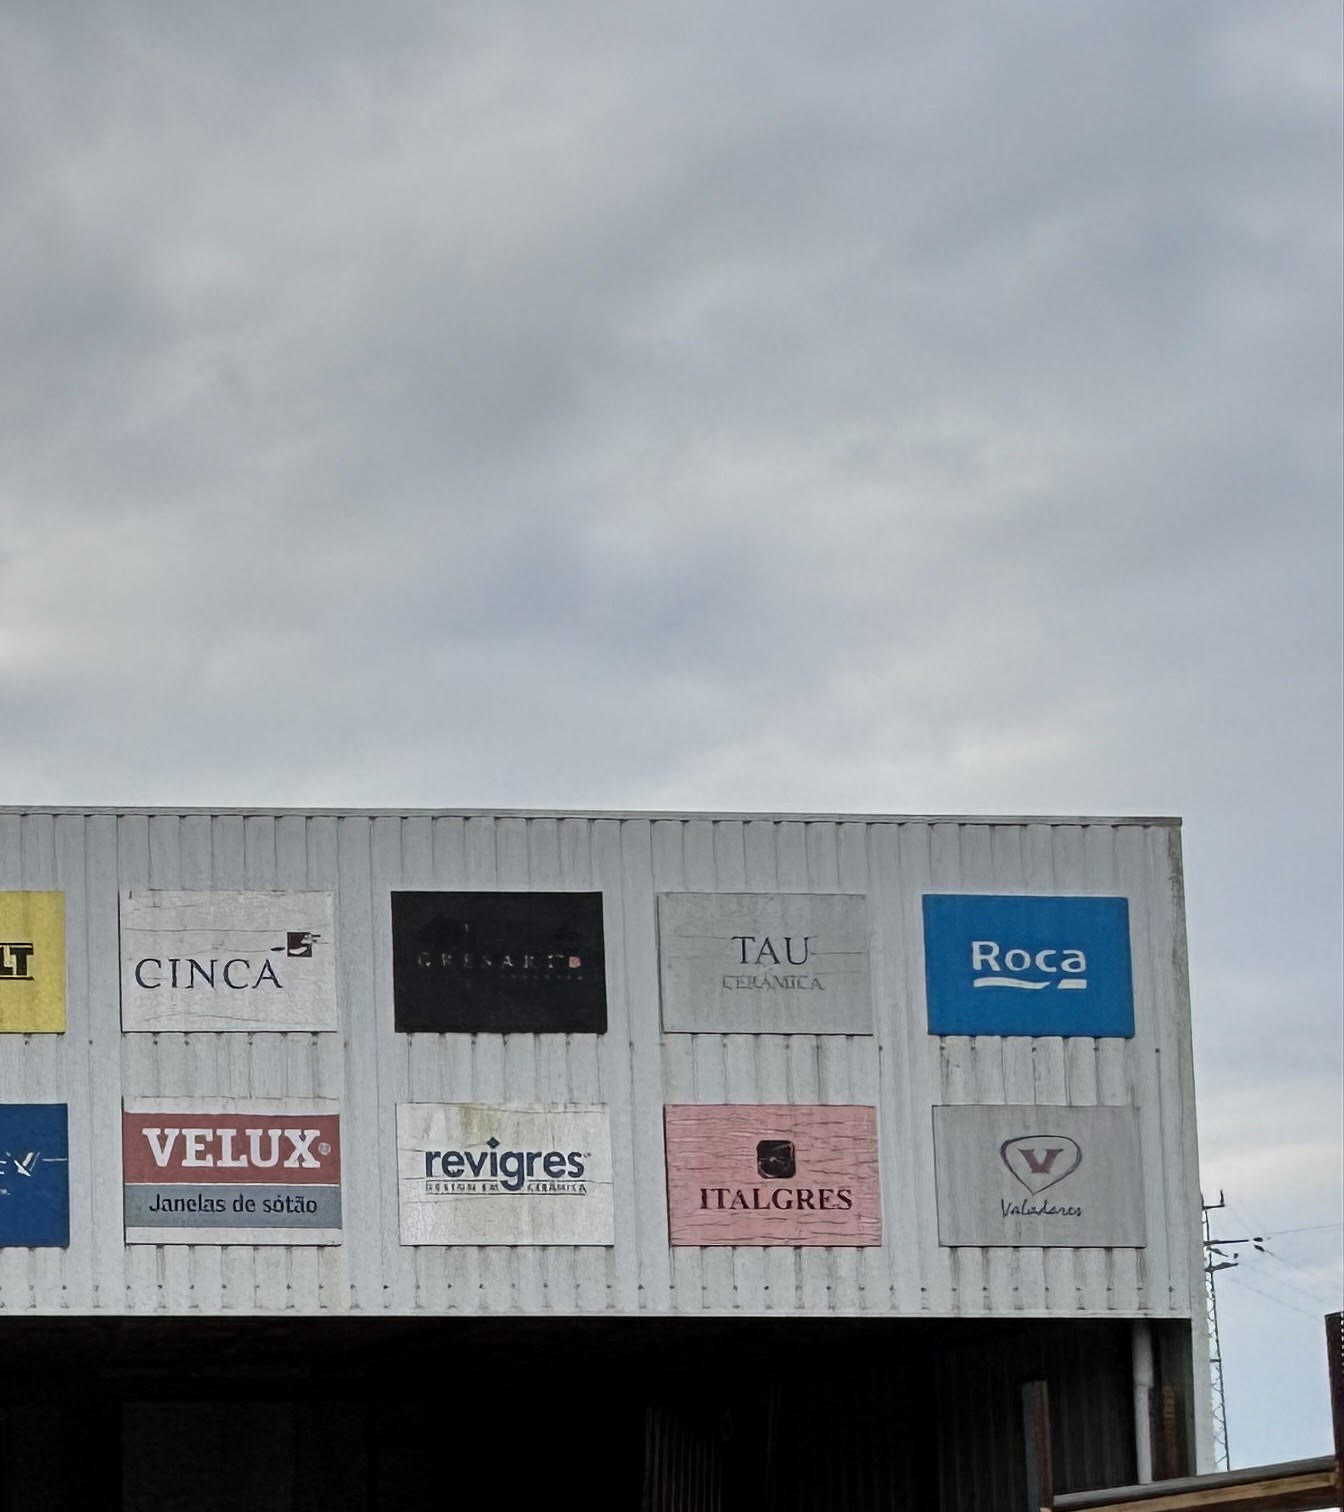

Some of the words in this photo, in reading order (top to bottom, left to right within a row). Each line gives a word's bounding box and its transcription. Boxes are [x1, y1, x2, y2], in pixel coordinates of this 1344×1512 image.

[731, 936, 809, 965] TAU
[971, 940, 1088, 973] Roca
[134, 957, 284, 990] CINCA
[141, 1127, 321, 1168] VELUX
[425, 1136, 585, 1191] revigres
[149, 1193, 226, 1214] Janelas
[232, 1193, 256, 1213] de
[263, 1195, 318, 1214] sótão
[700, 1187, 853, 1211] ITALGRES
